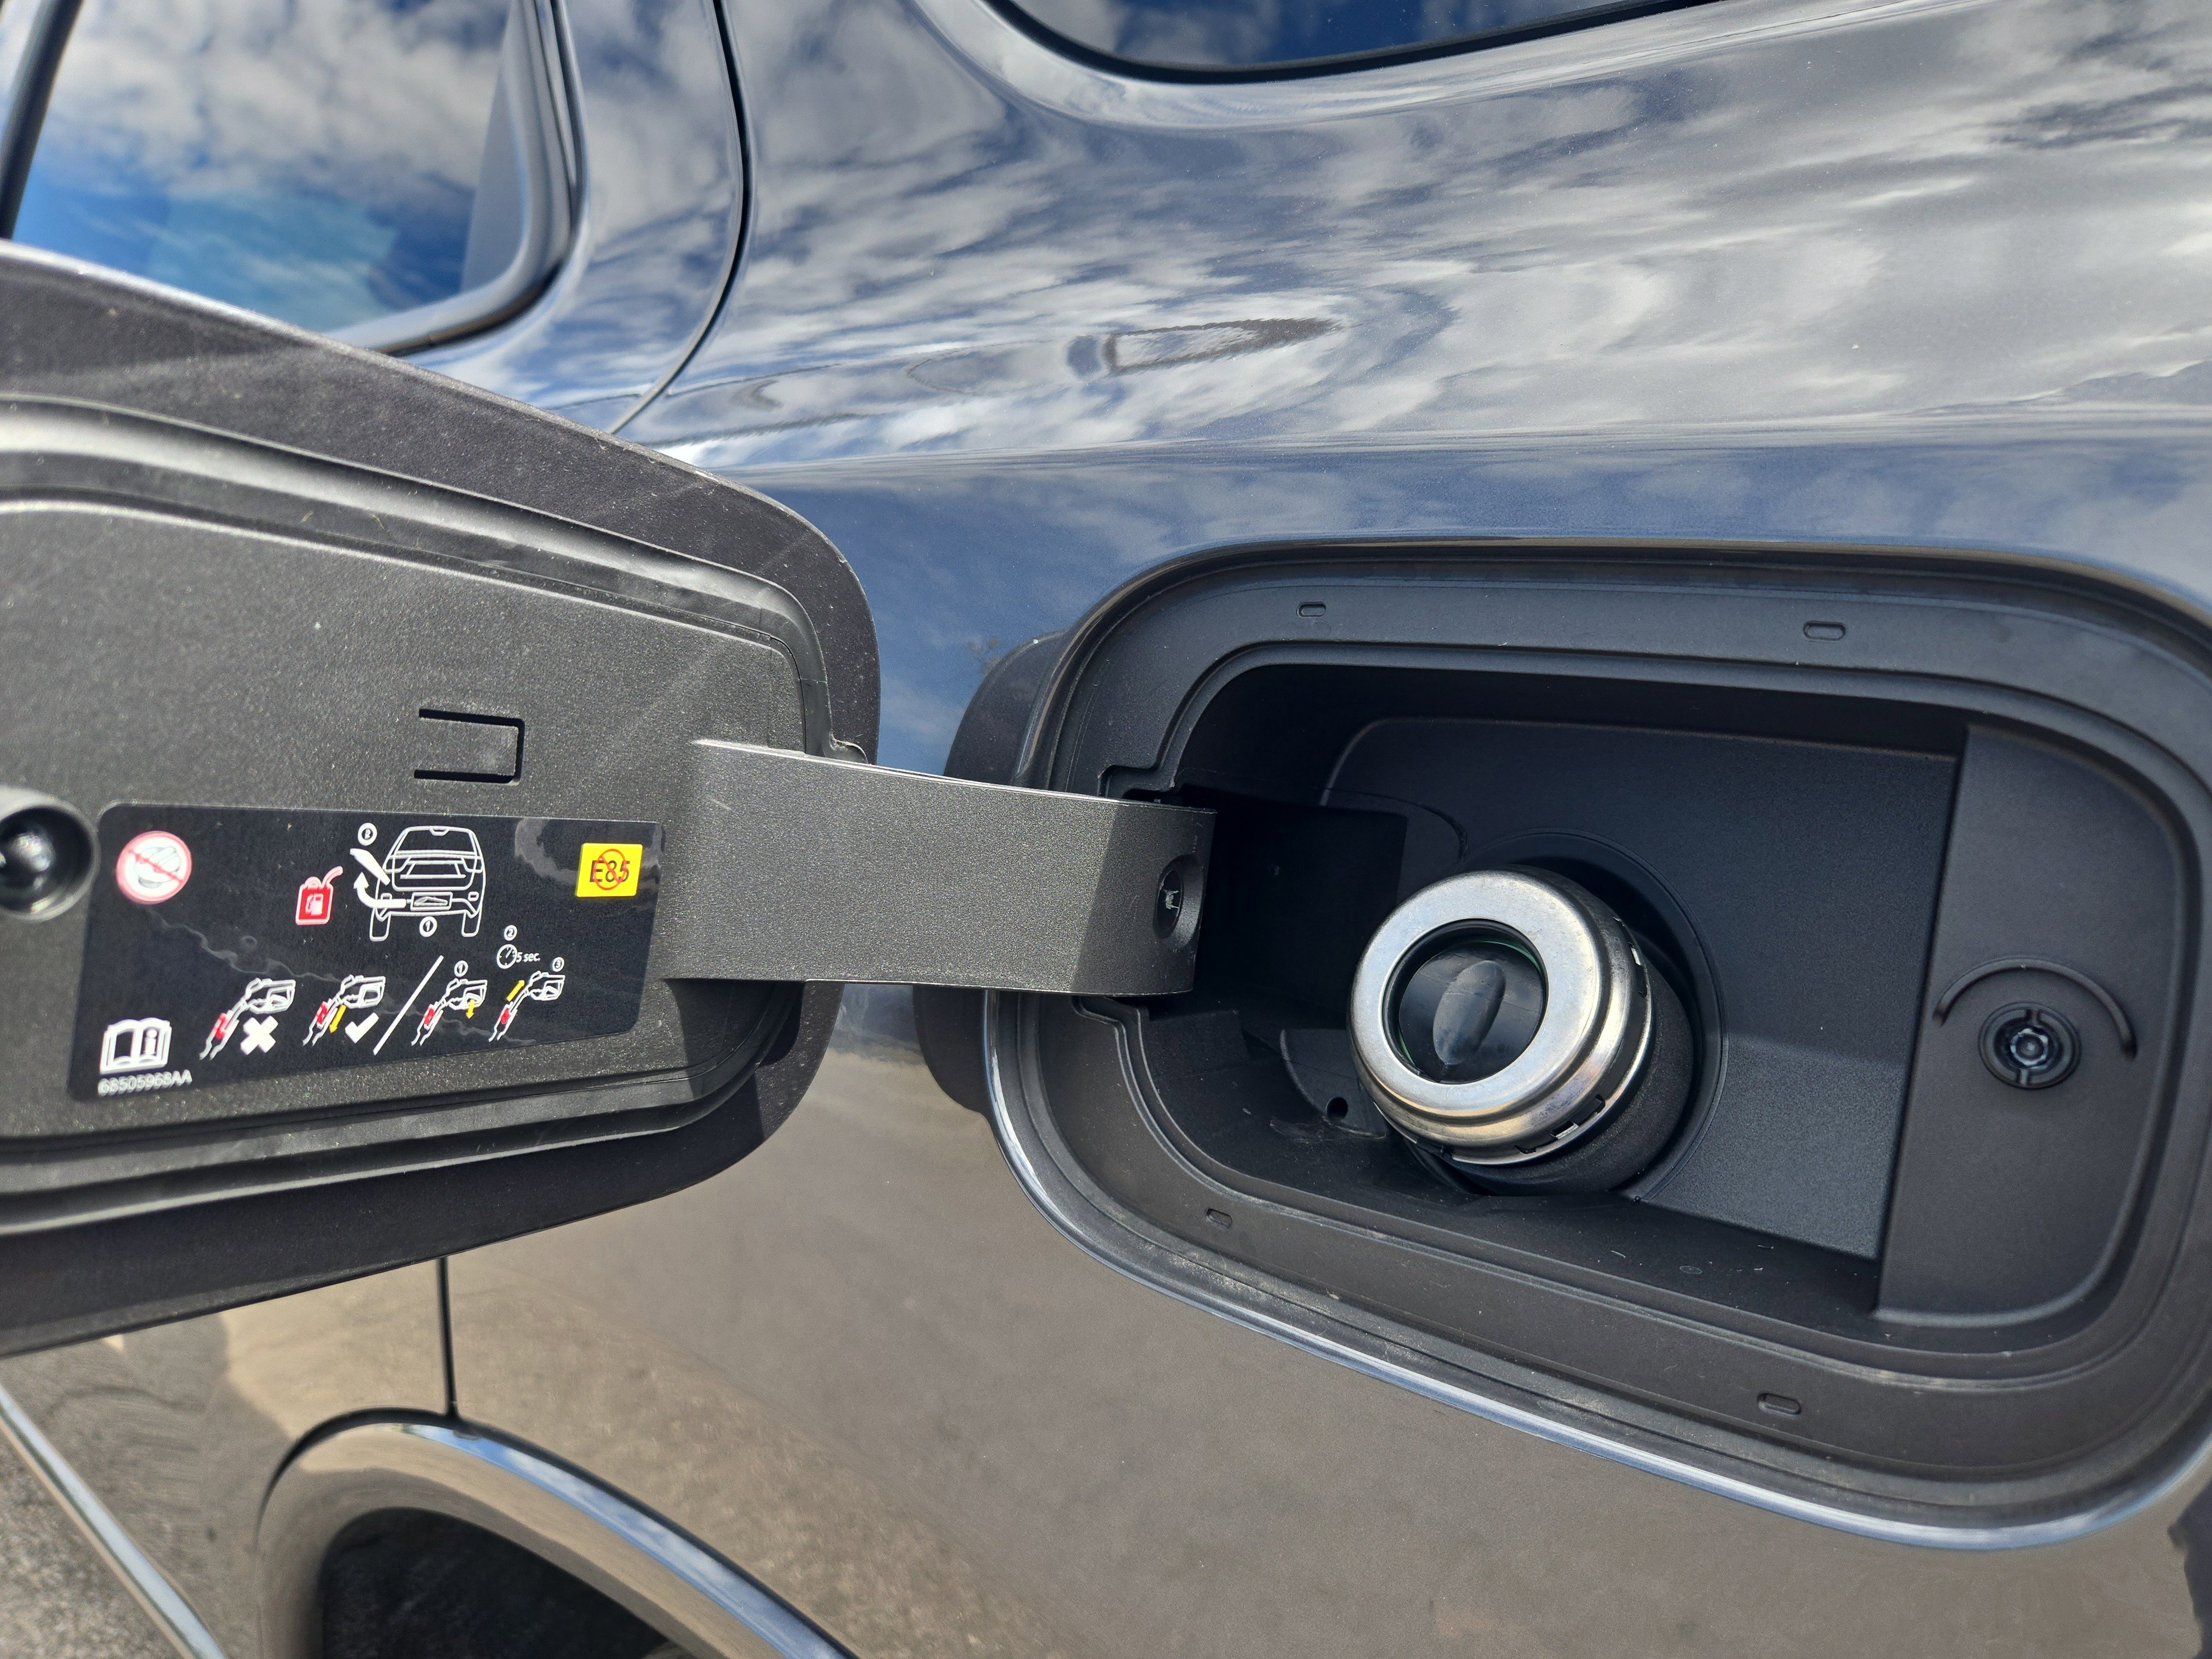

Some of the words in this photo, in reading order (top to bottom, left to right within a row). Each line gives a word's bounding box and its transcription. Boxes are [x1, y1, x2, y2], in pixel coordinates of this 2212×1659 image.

[589, 860, 631, 883] E85
[516, 951, 523, 963] 5
[523, 952, 541, 963] sec.
[98, 1069, 192, 1097] 68505968AA
